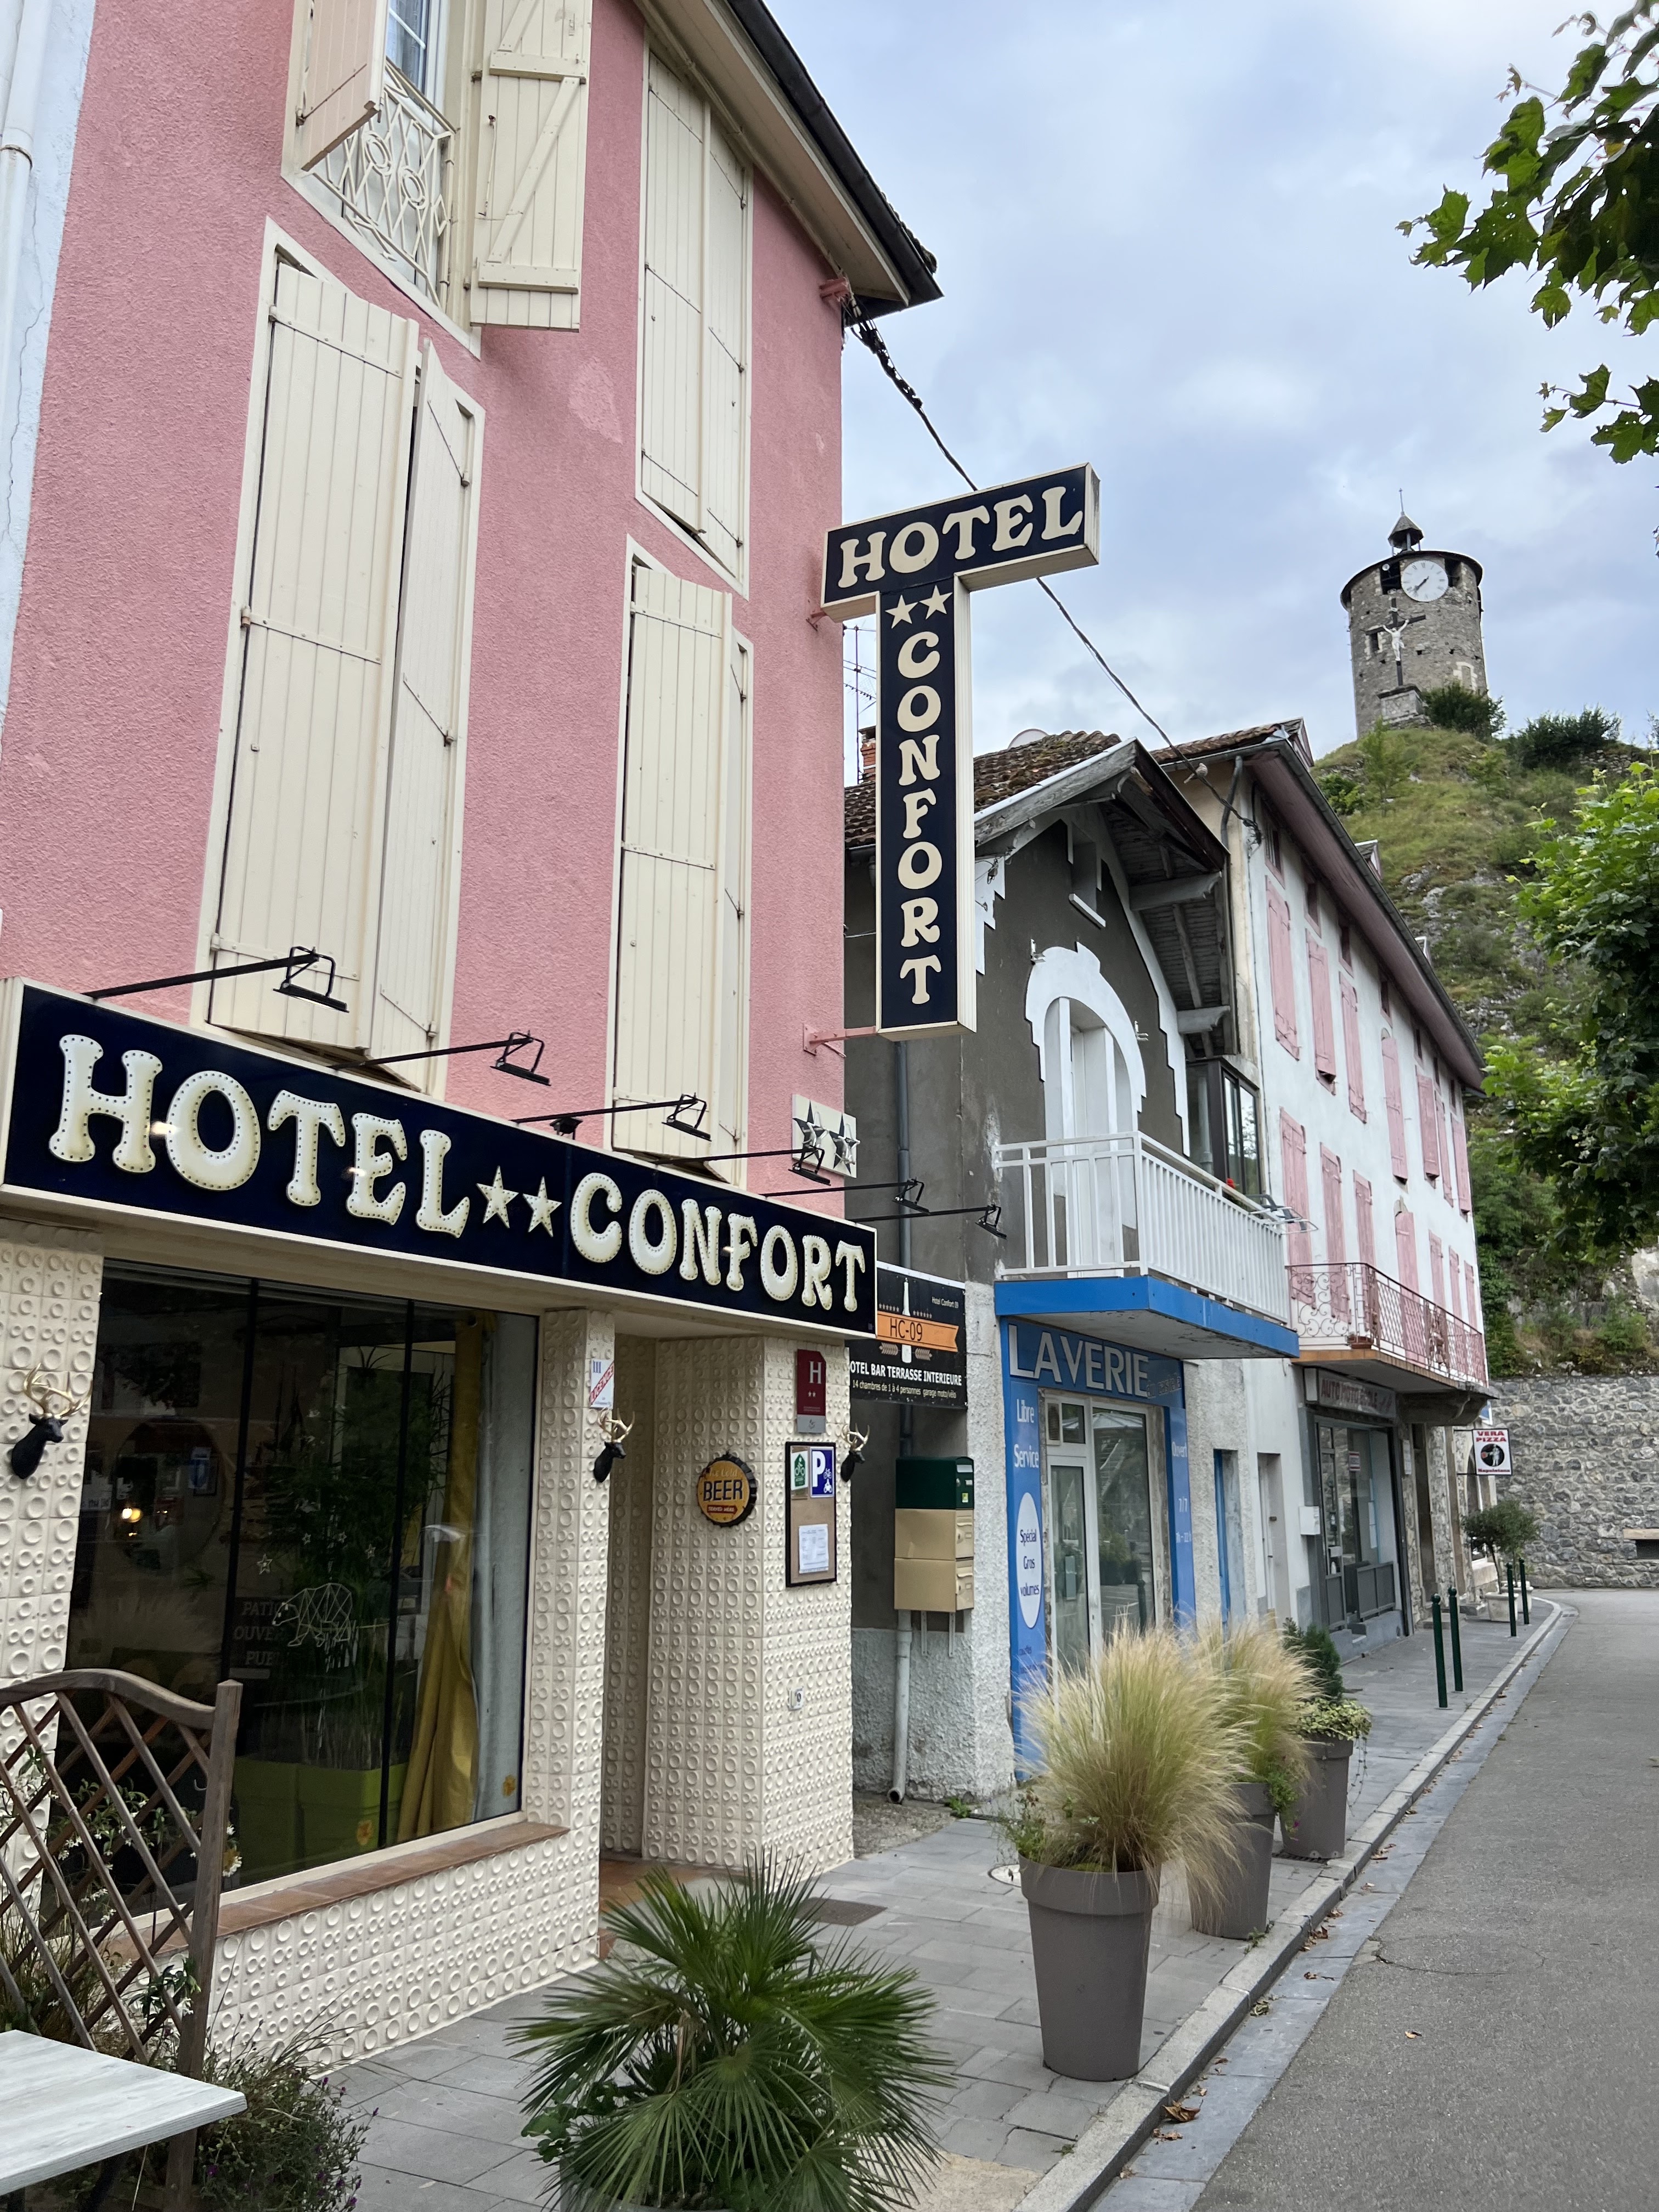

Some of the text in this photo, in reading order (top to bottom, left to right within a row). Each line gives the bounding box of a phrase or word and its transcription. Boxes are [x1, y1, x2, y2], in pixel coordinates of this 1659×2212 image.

[838, 486, 1084, 589] HOTEL
[898, 631, 942, 1005] CONFORT
[49, 1035, 865, 1312] HOTEL CONFORT
[890, 1318, 922, 1341] HC-09
[809, 1361, 822, 1384] H
[1008, 1324, 1149, 1397] LAVERIE
[850, 1361, 962, 1386] OTEL BAR TERRASSE INTERIEURE
[853, 1379, 859, 1389] 14
[860, 1380, 881, 1391] chambres
[881, 1383, 887, 1392] de
[896, 1385, 900, 1393] 4
[900, 1386, 921, 1395] personnes
[1321, 1378, 1340, 1401] AUTO
[1017, 1398, 1035, 1423] Libre
[1014, 1443, 1040, 1468] Service
[812, 1451, 826, 1487] P
[703, 1480, 742, 1501] BEER
[1020, 1528, 1037, 1546] Spécial
[1023, 1556, 1035, 1569] Gros
[1020, 1583, 1040, 1596] volumes
